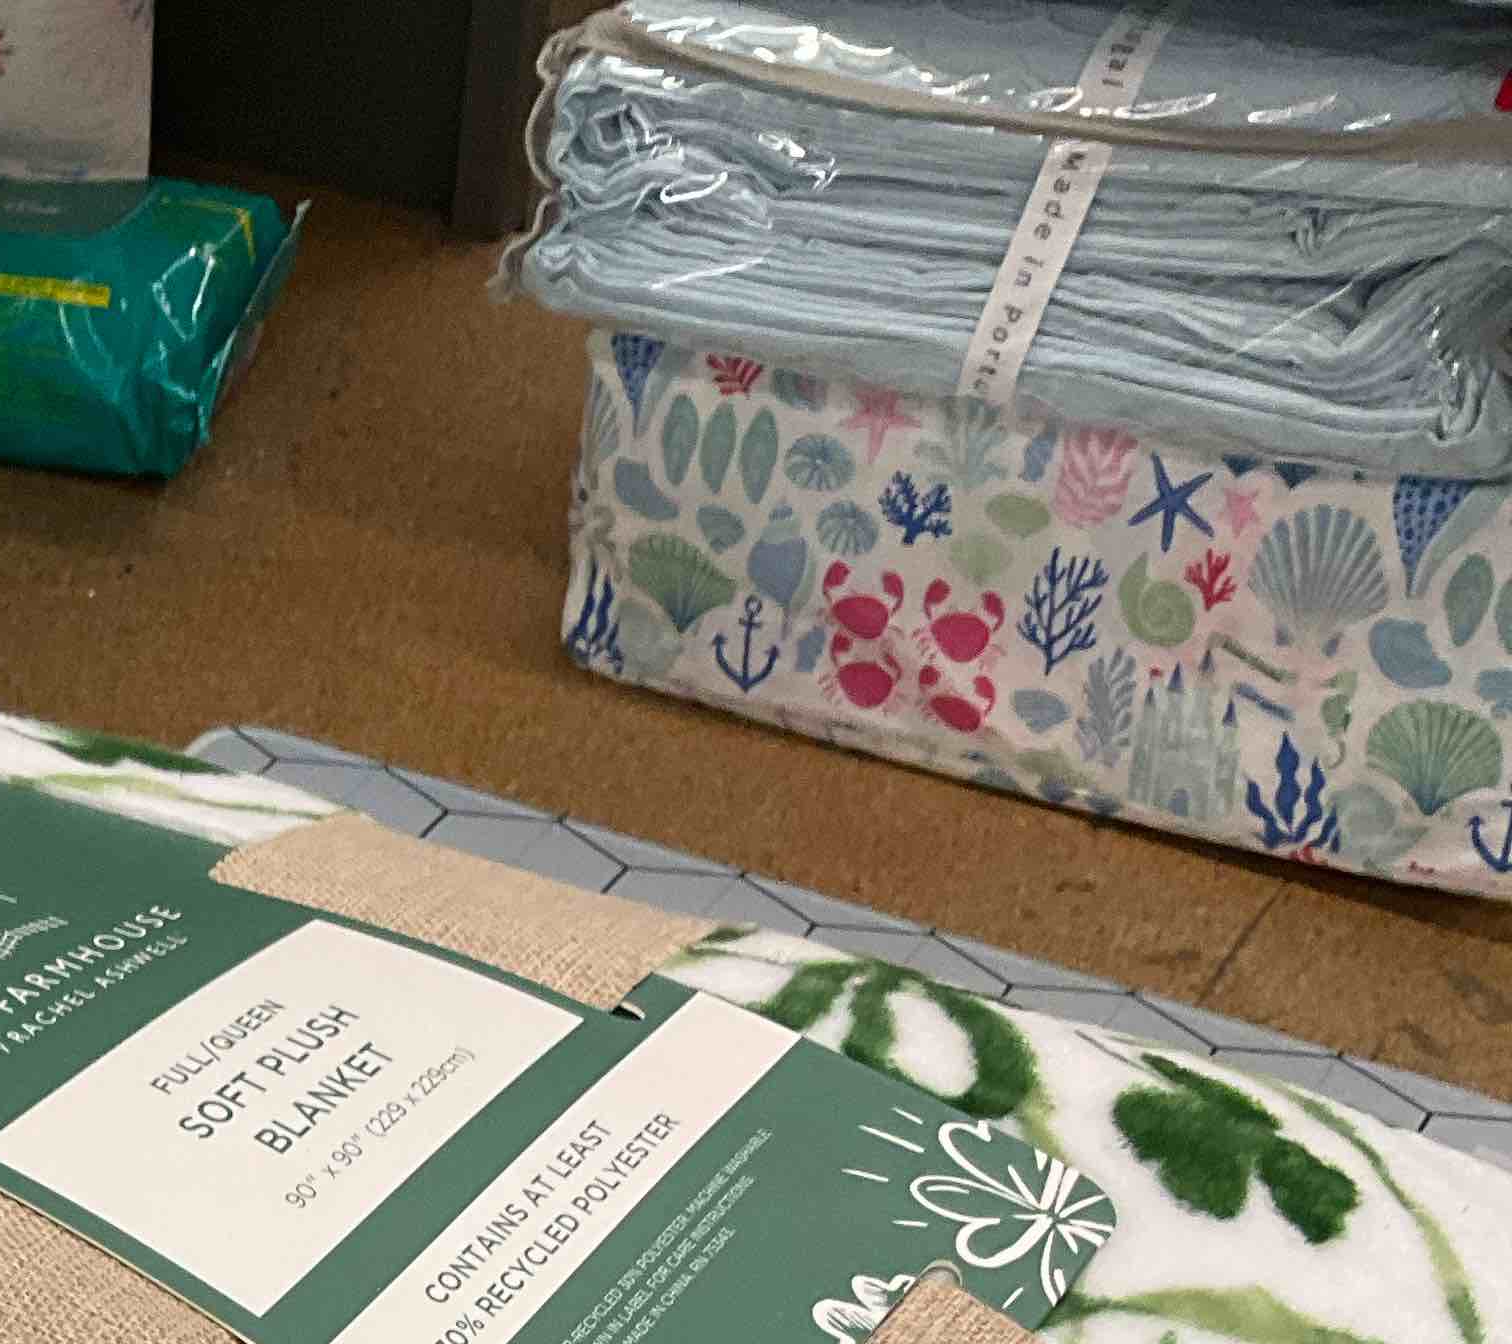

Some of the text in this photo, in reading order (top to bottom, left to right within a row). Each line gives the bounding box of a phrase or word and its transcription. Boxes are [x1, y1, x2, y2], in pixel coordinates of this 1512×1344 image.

[1033, 151, 1086, 241] Made
[1014, 256, 1044, 288] in
[6, 989, 96, 1044] RACHEL
[94, 933, 188, 989] ASHWELL
[149, 998, 286, 1095] FULL/QUEEN
[179, 1004, 361, 1140] SOFT PLUSH
[253, 1041, 394, 1155] BLANKET
[364, 1101, 408, 1139] (229
[409, 1044, 477, 1096] 229cm)
[424, 1119, 612, 1304] CONTAINS AT LEAST
[474, 1212, 581, 1317] RECYCLED
[571, 1112, 681, 1215] POLYESTER
[618, 1289, 654, 1322] LABEL
[646, 1265, 671, 1288] FOR
[666, 1238, 696, 1267] CARE
